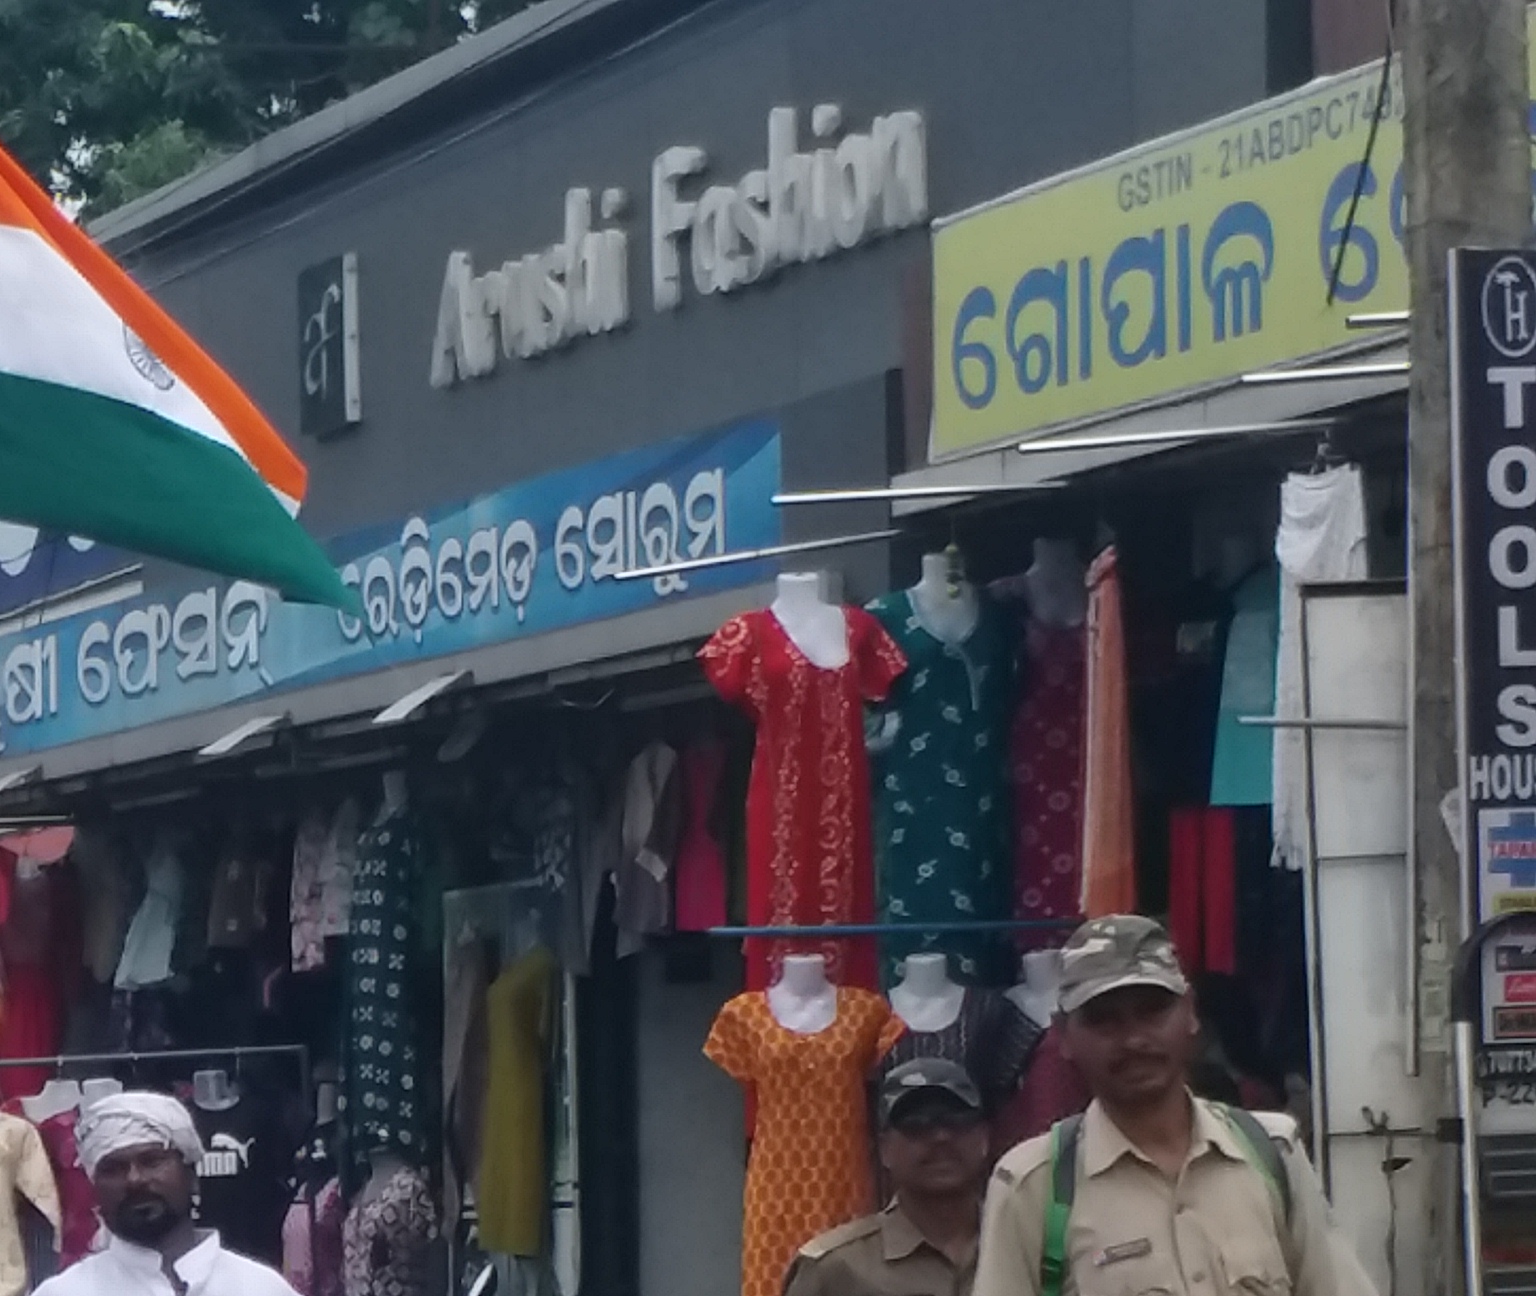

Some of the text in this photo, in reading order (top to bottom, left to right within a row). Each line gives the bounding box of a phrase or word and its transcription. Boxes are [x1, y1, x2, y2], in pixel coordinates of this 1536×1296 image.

[430, 187, 628, 388] Arushi
[651, 104, 927, 312] Fashion
[1117, 152, 1193, 214] GSTIN
[951, 200, 1274, 410] ଗୋପାଳ
[1469, 754, 1536, 800] HOU
